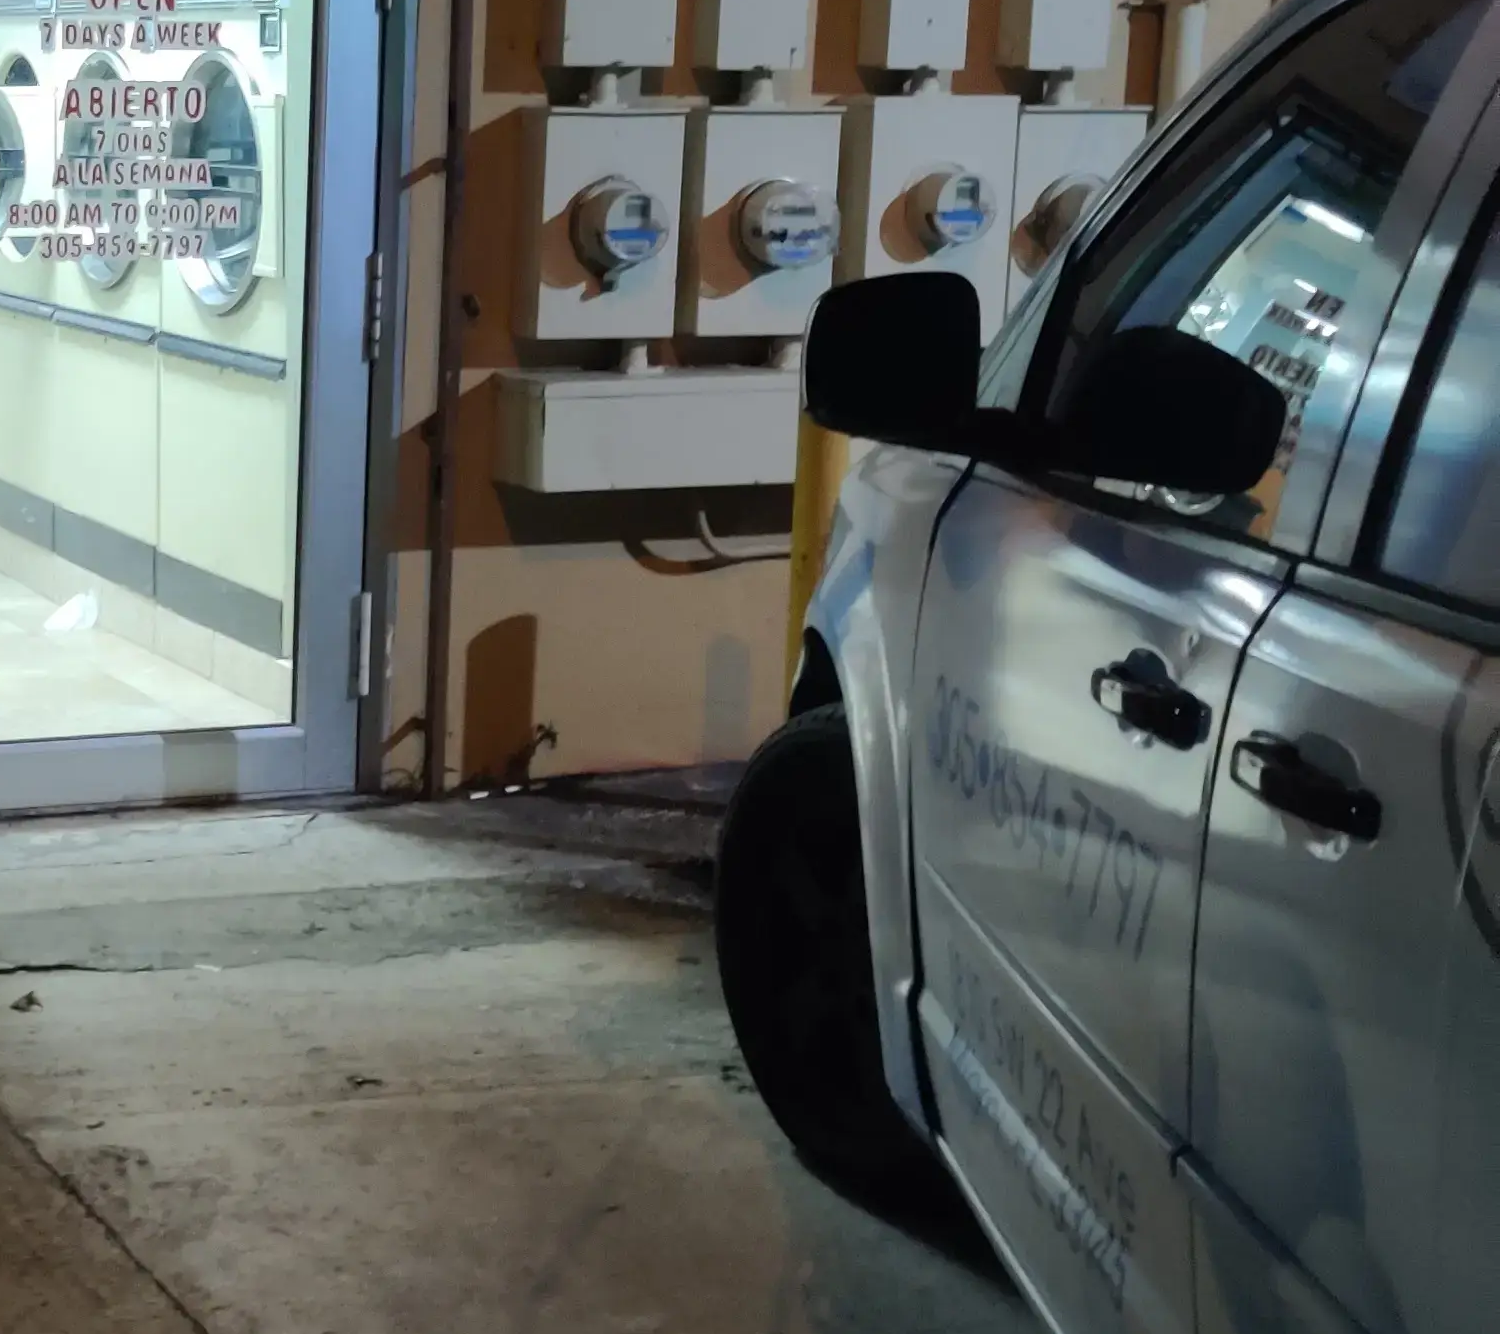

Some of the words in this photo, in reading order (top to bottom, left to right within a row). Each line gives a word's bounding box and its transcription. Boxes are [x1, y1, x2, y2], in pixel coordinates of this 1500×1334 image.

[43, 23, 52, 44] 7
[65, 22, 124, 47] DAYS
[136, 24, 148, 45] A
[157, 22, 222, 47] WEEK
[65, 86, 202, 119] ABIERTO
[96, 130, 106, 152] 7
[117, 131, 168, 154] DIAS
[55, 164, 69, 187] A
[78, 162, 104, 186] LA
[114, 162, 208, 186] SEMANA
[9, 203, 58, 226] 8:00
[65, 204, 102, 226] AM
[111, 203, 137, 225] TO
[148, 203, 196, 227] 9:00
[205, 203, 238, 229] PM
